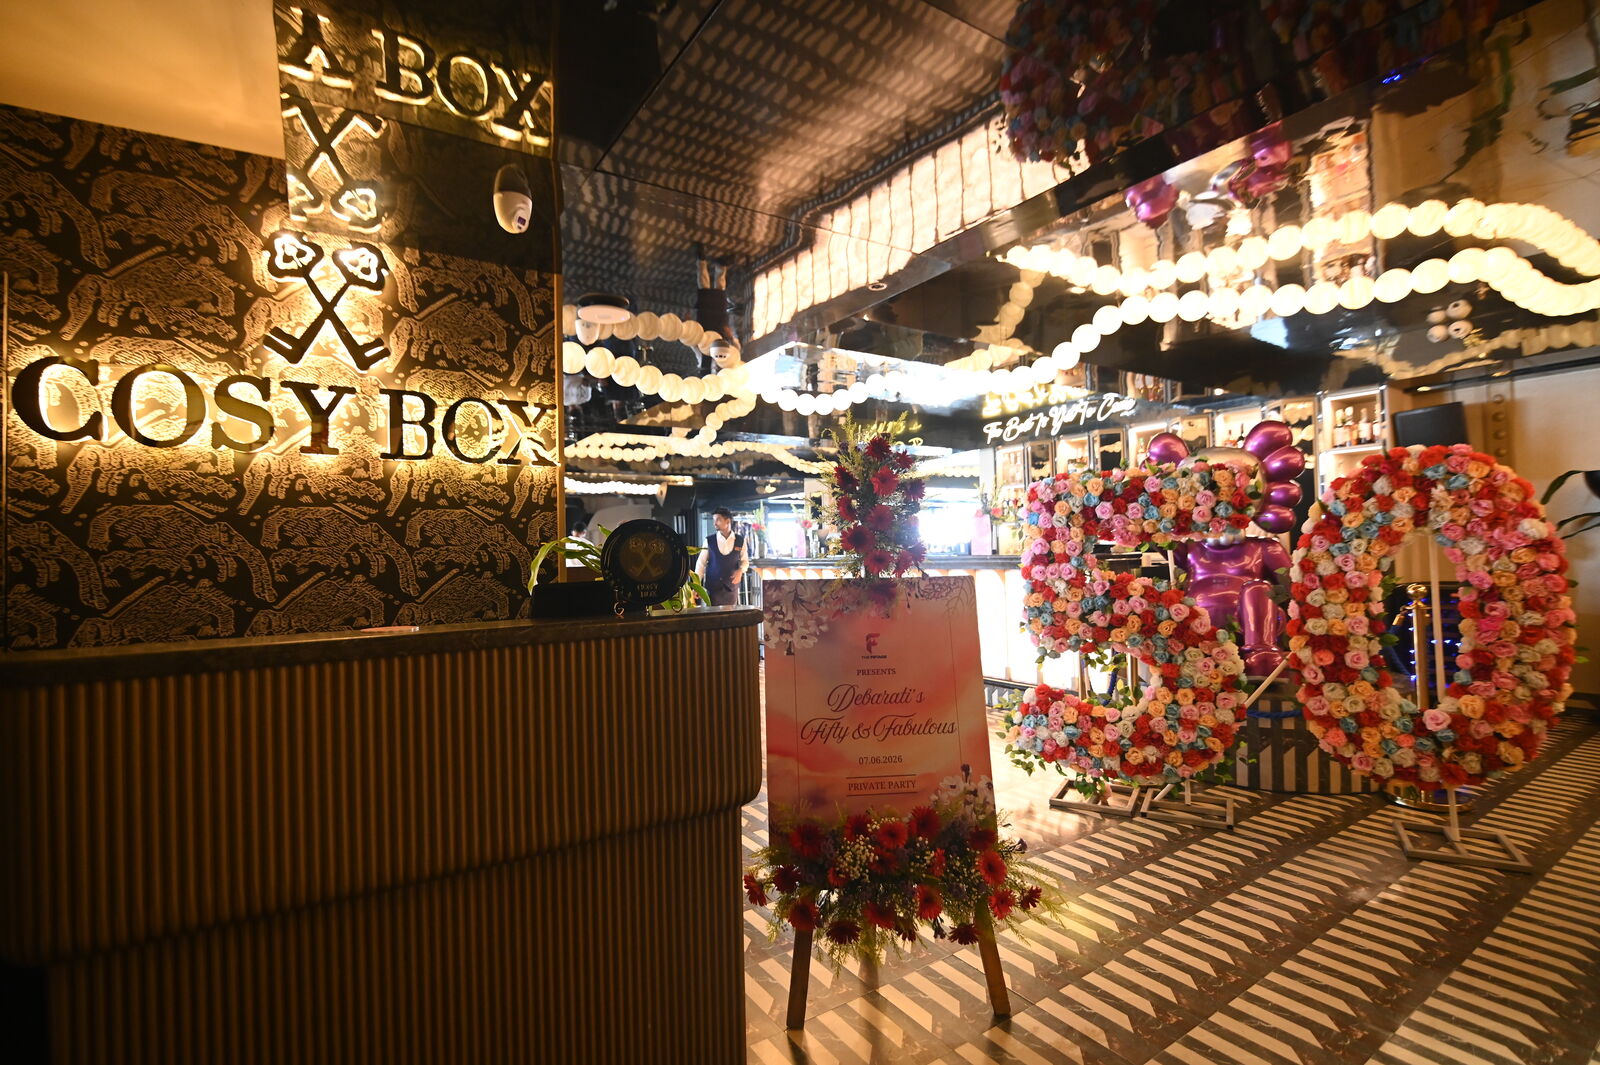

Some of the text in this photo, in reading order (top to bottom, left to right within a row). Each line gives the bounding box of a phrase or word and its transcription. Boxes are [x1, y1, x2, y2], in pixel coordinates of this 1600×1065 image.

[12, 355, 559, 467] COSY BOX
[856, 668, 896, 676] PRESENTS
[827, 683, 925, 712] Debarati's
[800, 713, 957, 745] Fifty & Fabulous
[858, 755, 903, 765] 07.06.2026
[848, 779, 917, 791] PRIVATE PARTY
